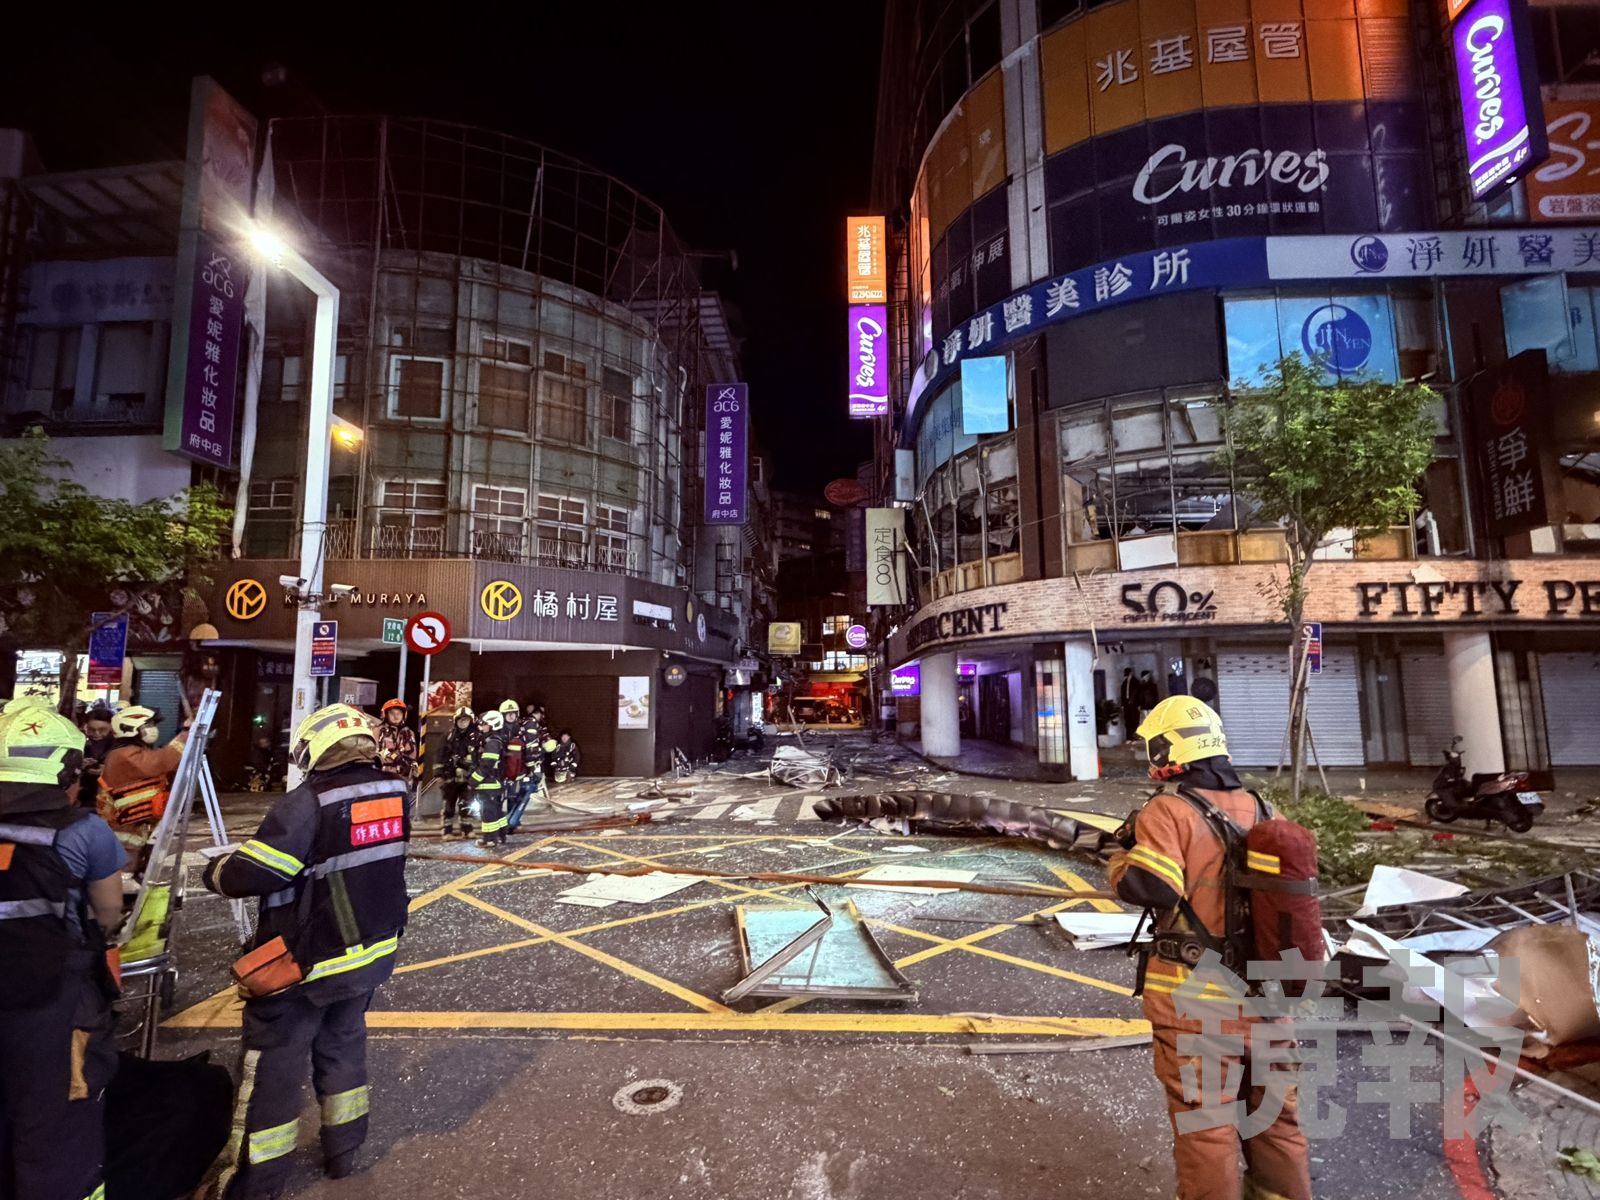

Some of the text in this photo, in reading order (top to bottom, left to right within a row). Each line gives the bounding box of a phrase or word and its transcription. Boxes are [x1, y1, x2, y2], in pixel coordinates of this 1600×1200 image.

[1096, 23, 1301, 92] 兆基屋管
[1466, 15, 1504, 144] Curves
[1133, 143, 1329, 205] Curves
[942, 248, 1192, 366] 淨妍醫美診所
[198, 295, 224, 433] 愛妮雅化妝品
[856, 317, 882, 387] Curves
[189, 433, 223, 457] 府中店
[719, 416, 733, 505] 愛妮雅化妝品
[711, 509, 739, 519] 府中店
[351, 593, 426, 604] MURAYA
[533, 588, 618, 621] 橘村屋
[1121, 581, 1217, 613] 50%
[1123, 611, 1218, 623] FIFTY PERCENT
[1357, 580, 1523, 617] FIFTY
